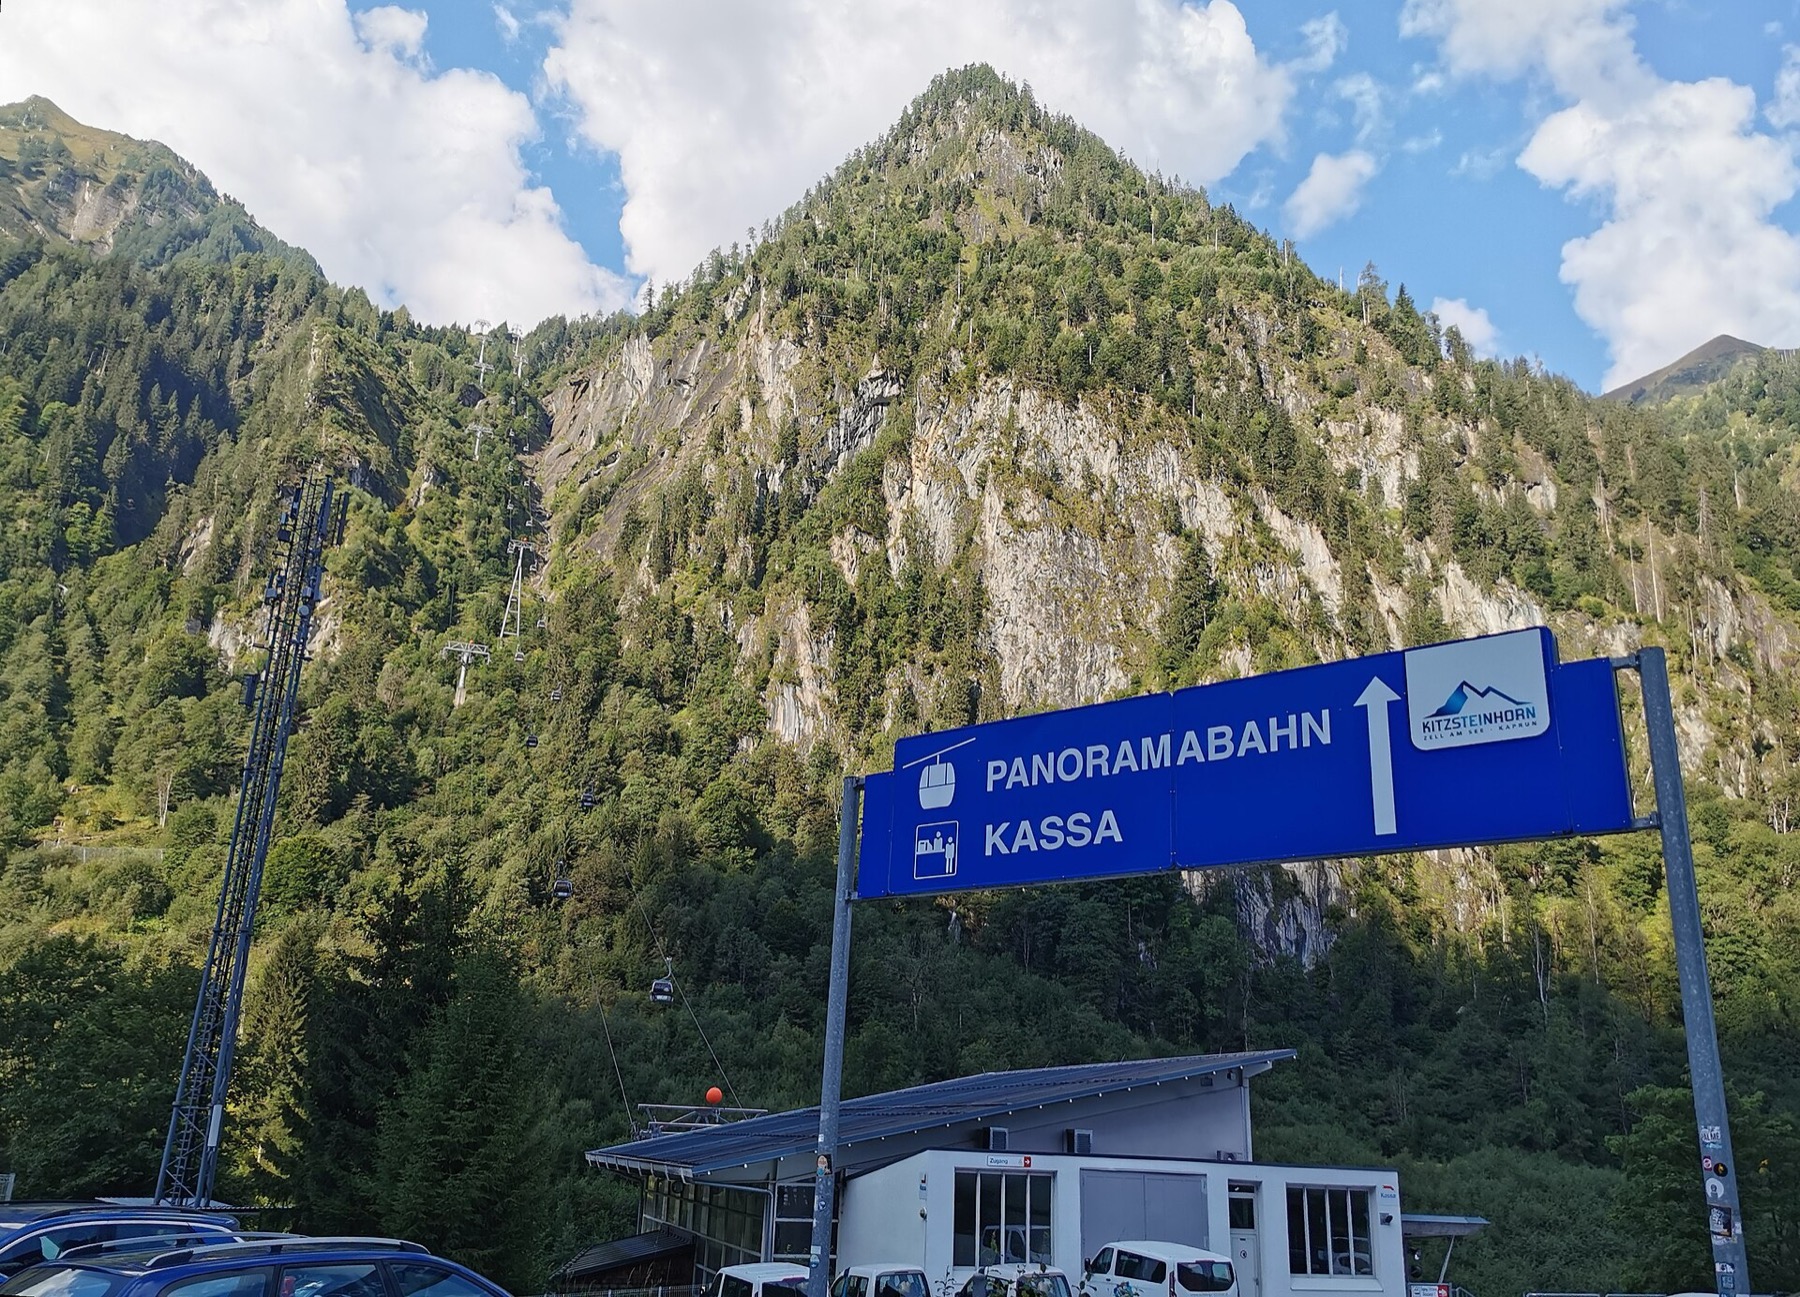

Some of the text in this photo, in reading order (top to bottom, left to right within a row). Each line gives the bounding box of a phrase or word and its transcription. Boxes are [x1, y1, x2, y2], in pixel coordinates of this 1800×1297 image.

[1422, 706, 1536, 733] KITZSTEINHORN
[1423, 733, 1444, 741] ZELL
[1498, 720, 1538, 731] KAPRUN
[987, 708, 1332, 792] PANORAMABAHN
[984, 809, 1123, 856] KASSA
